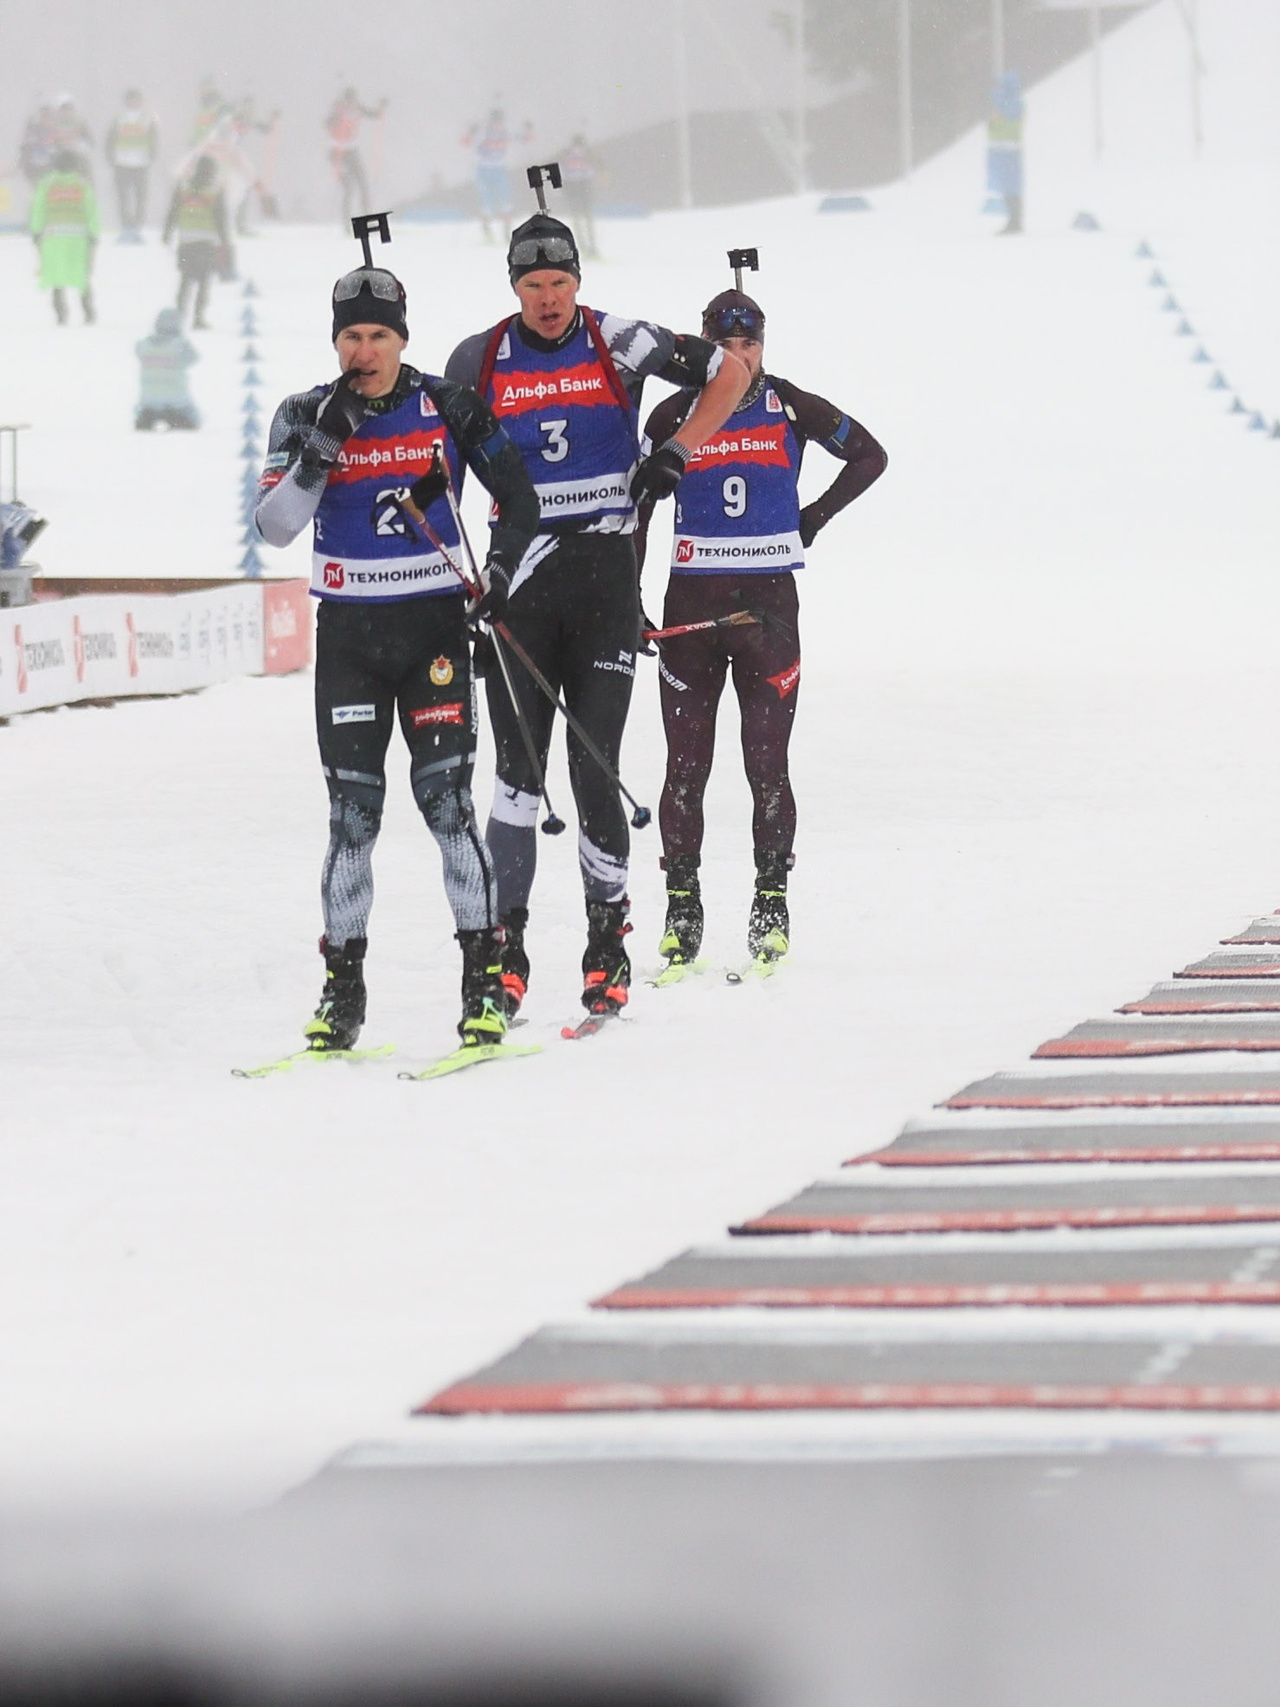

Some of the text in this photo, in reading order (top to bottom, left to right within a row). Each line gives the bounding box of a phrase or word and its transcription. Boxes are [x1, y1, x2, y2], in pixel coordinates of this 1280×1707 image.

[503, 377, 603, 400] Альфа Банк
[540, 420, 569, 463] 3
[741, 437, 778, 451] Банк
[337, 449, 392, 467] Альфа
[539, 485, 626, 507] НОНИКОЛЬ
[723, 476, 747, 518] 9
[376, 490, 405, 536] 2
[697, 544, 791, 558] ТЕХНОНИКОЛЬ
[348, 564, 452, 583] ТЕХНОНИКОЛ
